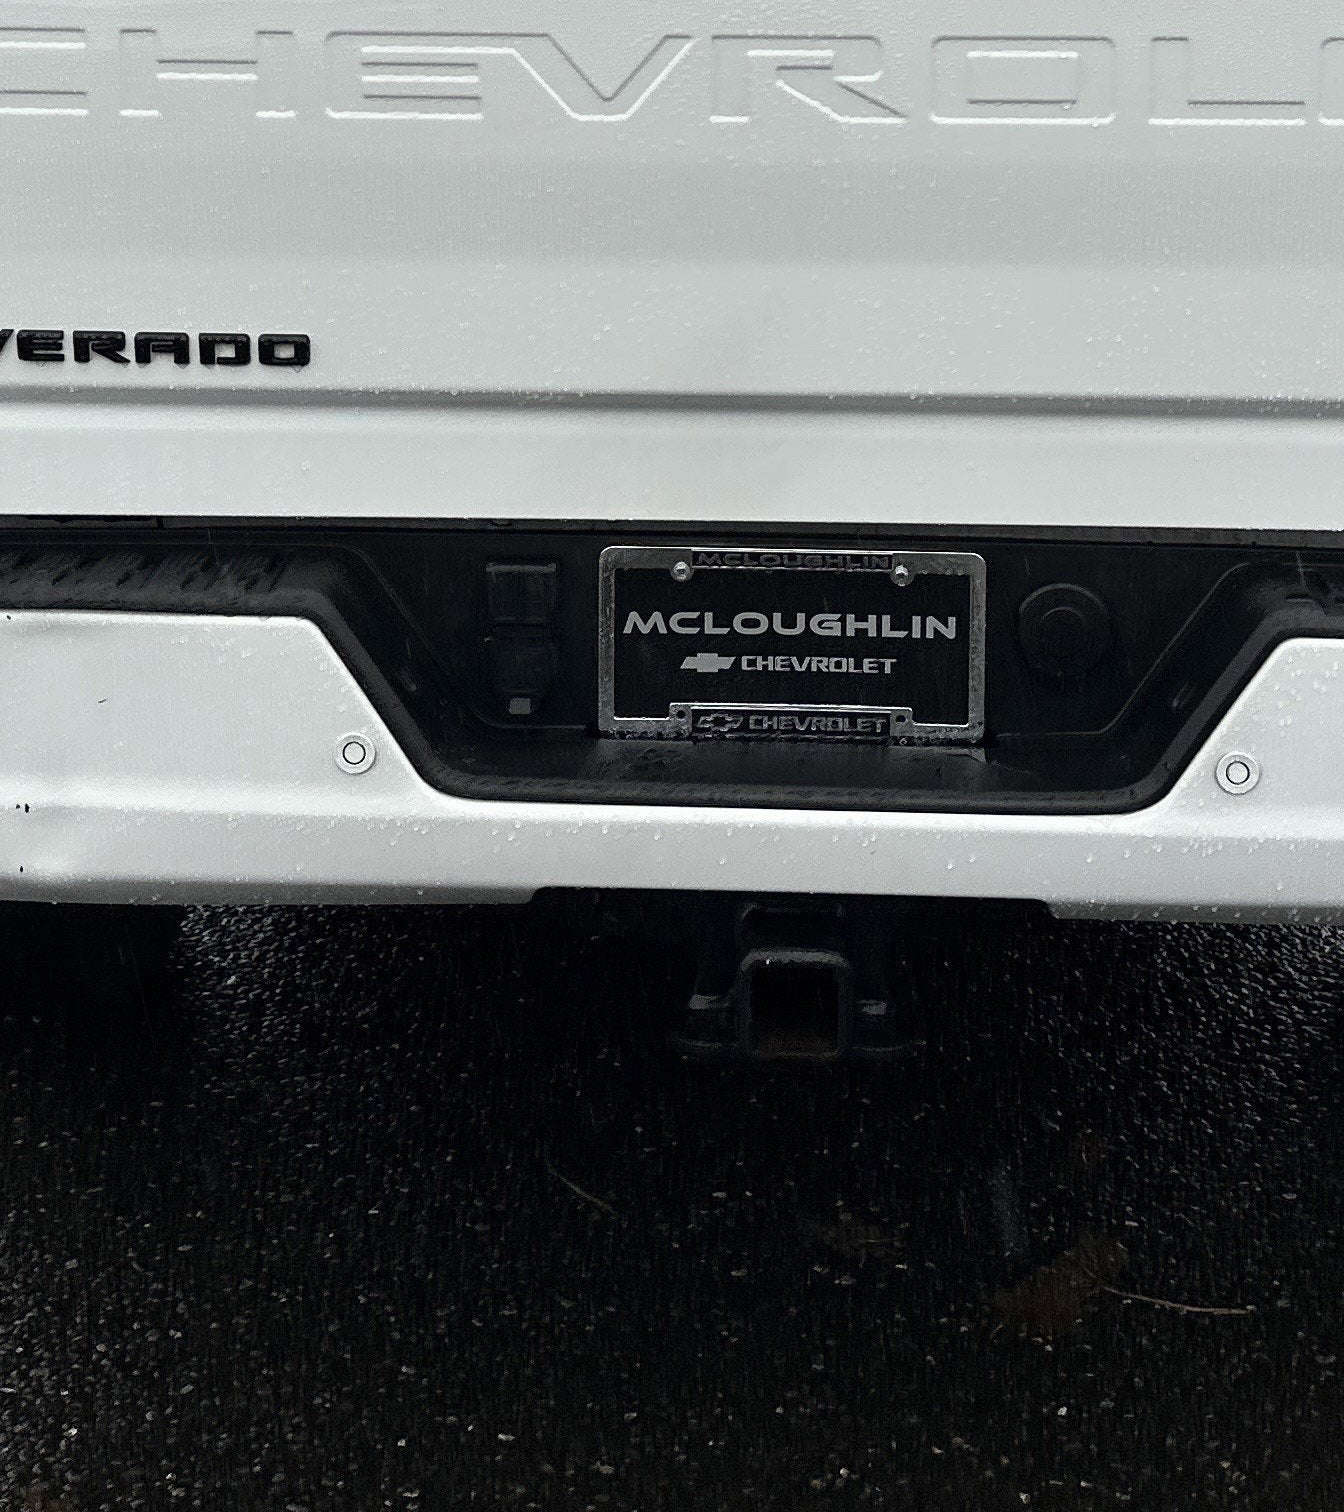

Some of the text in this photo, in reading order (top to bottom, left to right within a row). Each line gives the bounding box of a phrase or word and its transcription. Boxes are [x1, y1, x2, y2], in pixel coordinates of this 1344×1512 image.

[694, 552, 892, 569] MCLOUGHLIN
[622, 610, 957, 640] MCLOUGHLIN
[740, 654, 898, 674] CHEVROLET
[748, 714, 888, 734] CHEVROLET
